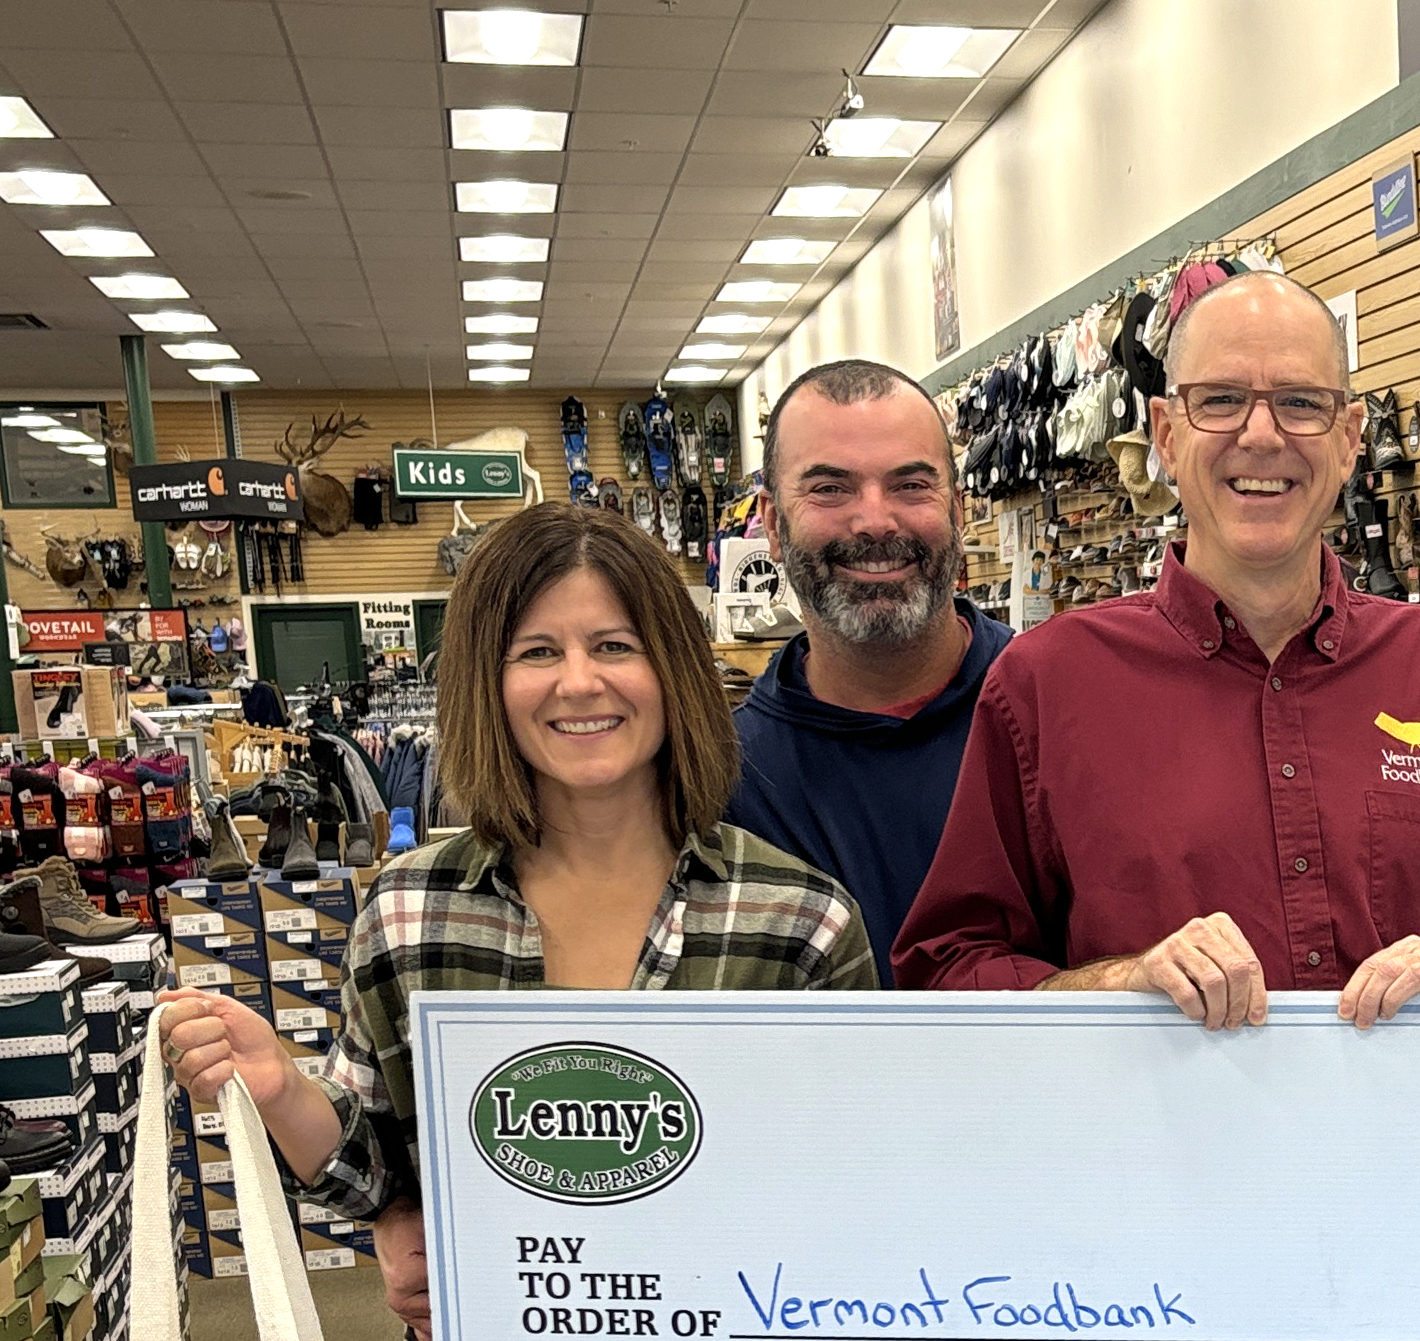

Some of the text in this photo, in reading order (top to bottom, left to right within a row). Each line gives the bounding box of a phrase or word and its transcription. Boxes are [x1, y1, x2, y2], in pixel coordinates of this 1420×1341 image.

[409, 461, 466, 485] Kids
[137, 480, 207, 502] carhartt
[238, 480, 285, 500] carhartt
[179, 500, 209, 512] WOMAN
[362, 601, 411, 615] Fitting
[365, 618, 411, 629] Rooms
[543, 1057, 566, 1073] Fit
[569, 1056, 599, 1070] You
[491, 1088, 686, 1154] Lenny's
[496, 1143, 679, 1191] SHOE & APPAREL
[516, 1236, 586, 1264] PAY
[519, 1272, 662, 1300] TO THE
[738, 1263, 1196, 1332] Vermont Foodbank
[522, 1307, 722, 1337] ORDER OF
